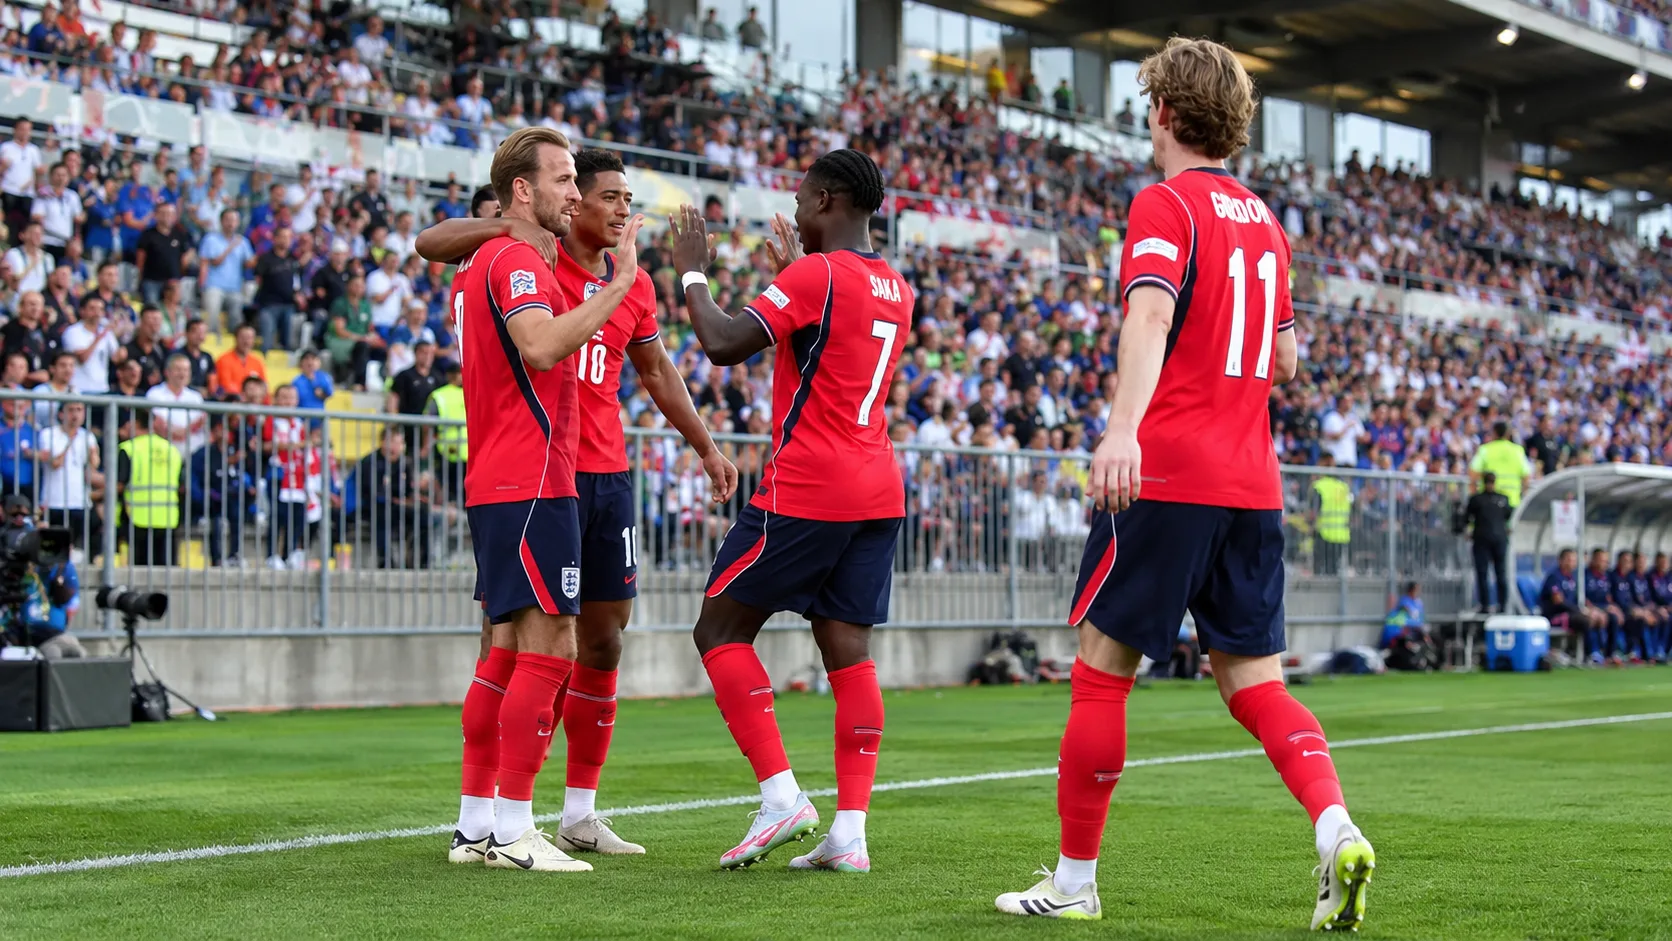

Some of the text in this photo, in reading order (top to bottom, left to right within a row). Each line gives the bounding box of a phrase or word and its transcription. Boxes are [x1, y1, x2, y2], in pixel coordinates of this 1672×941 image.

[869, 274, 901, 303] SAKA
[1225, 246, 1277, 380] 11
[577, 341, 608, 385] 10
[857, 319, 898, 426] 7
